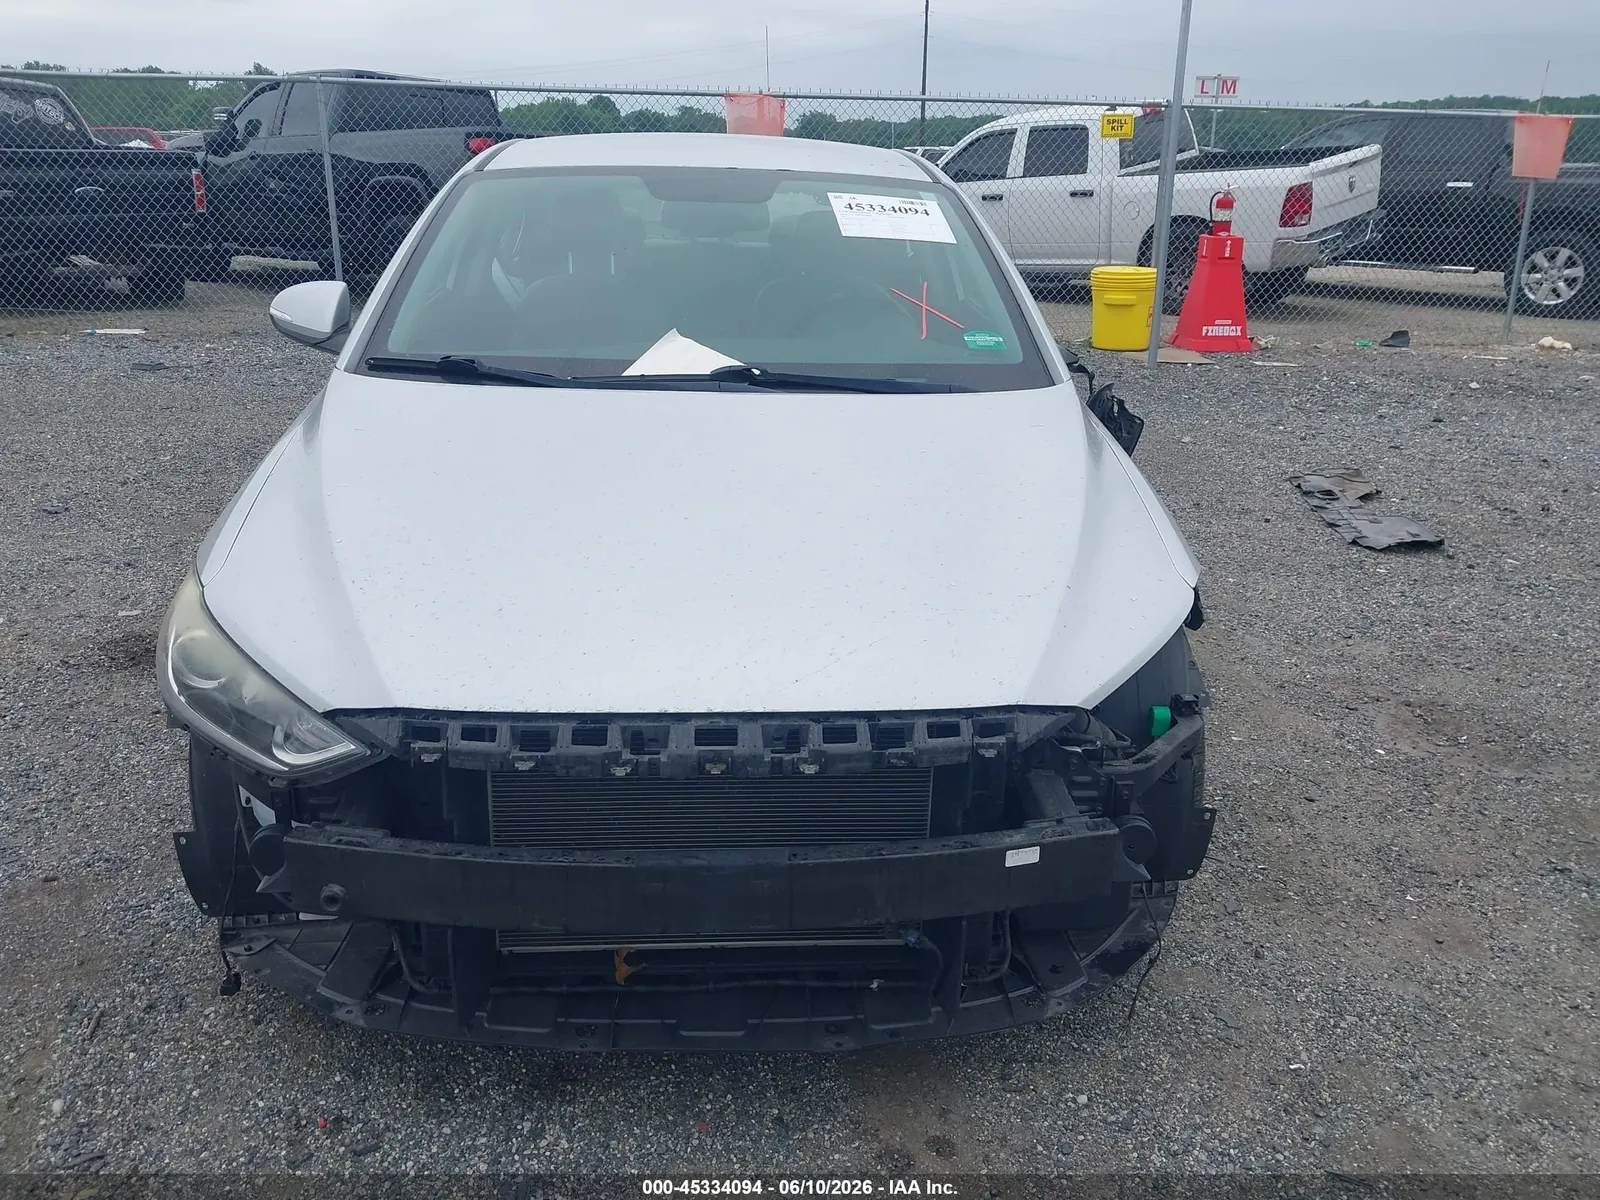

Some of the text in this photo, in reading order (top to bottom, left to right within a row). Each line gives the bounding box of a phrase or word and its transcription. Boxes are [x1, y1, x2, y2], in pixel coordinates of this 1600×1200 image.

[1200, 79, 1209, 94] L
[1220, 79, 1237, 94] M
[843, 202, 931, 217] 45334094
